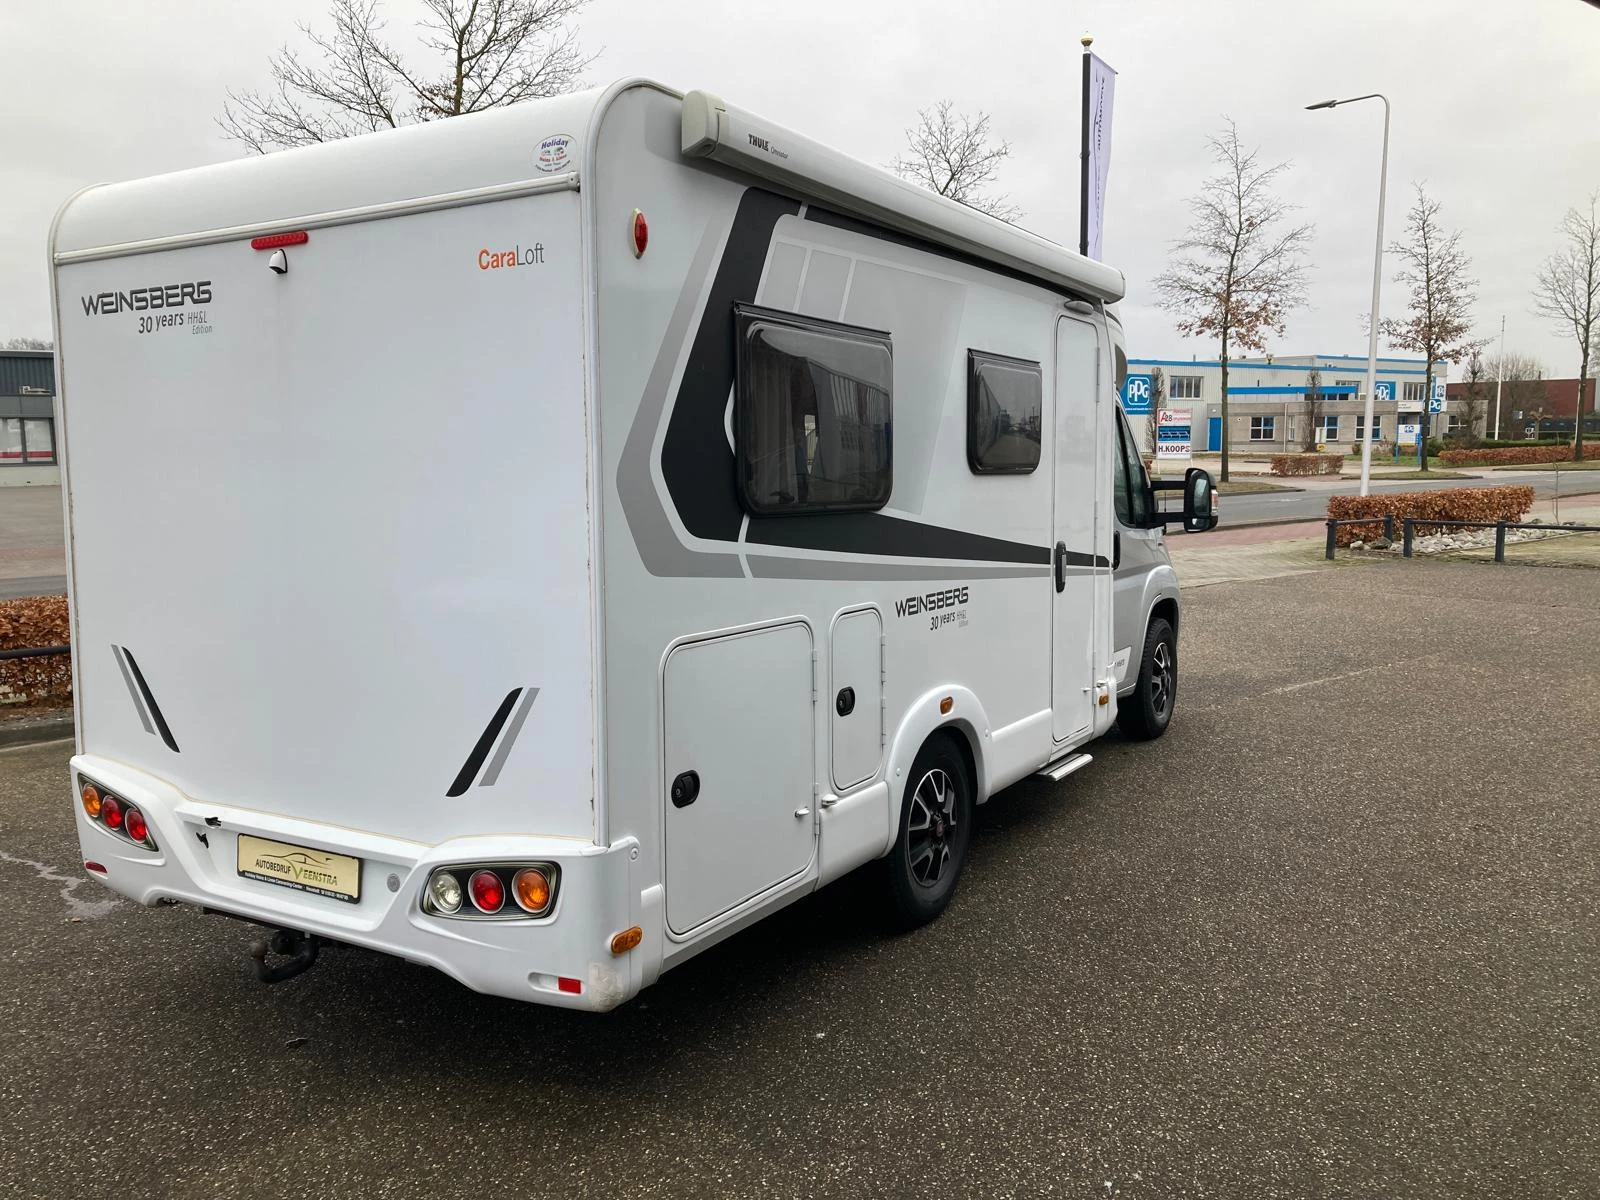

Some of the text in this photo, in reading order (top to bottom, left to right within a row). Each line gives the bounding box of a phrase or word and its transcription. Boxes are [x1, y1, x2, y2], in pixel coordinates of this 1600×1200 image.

[541, 138, 569, 150] Holiday
[748, 133, 769, 152] THULE
[478, 243, 545, 270] CaraLoft
[81, 280, 212, 317] WEINSBERG
[138, 316, 153, 334] 30
[155, 312, 184, 332] years
[192, 324, 213, 335] Edition
[1128, 380, 1149, 402] PPG
[895, 586, 969, 618] WEINSBERG
[930, 615, 939, 631] 30
[939, 612, 956, 628] years
[255, 858, 292, 875] AUTOBEDRIJF
